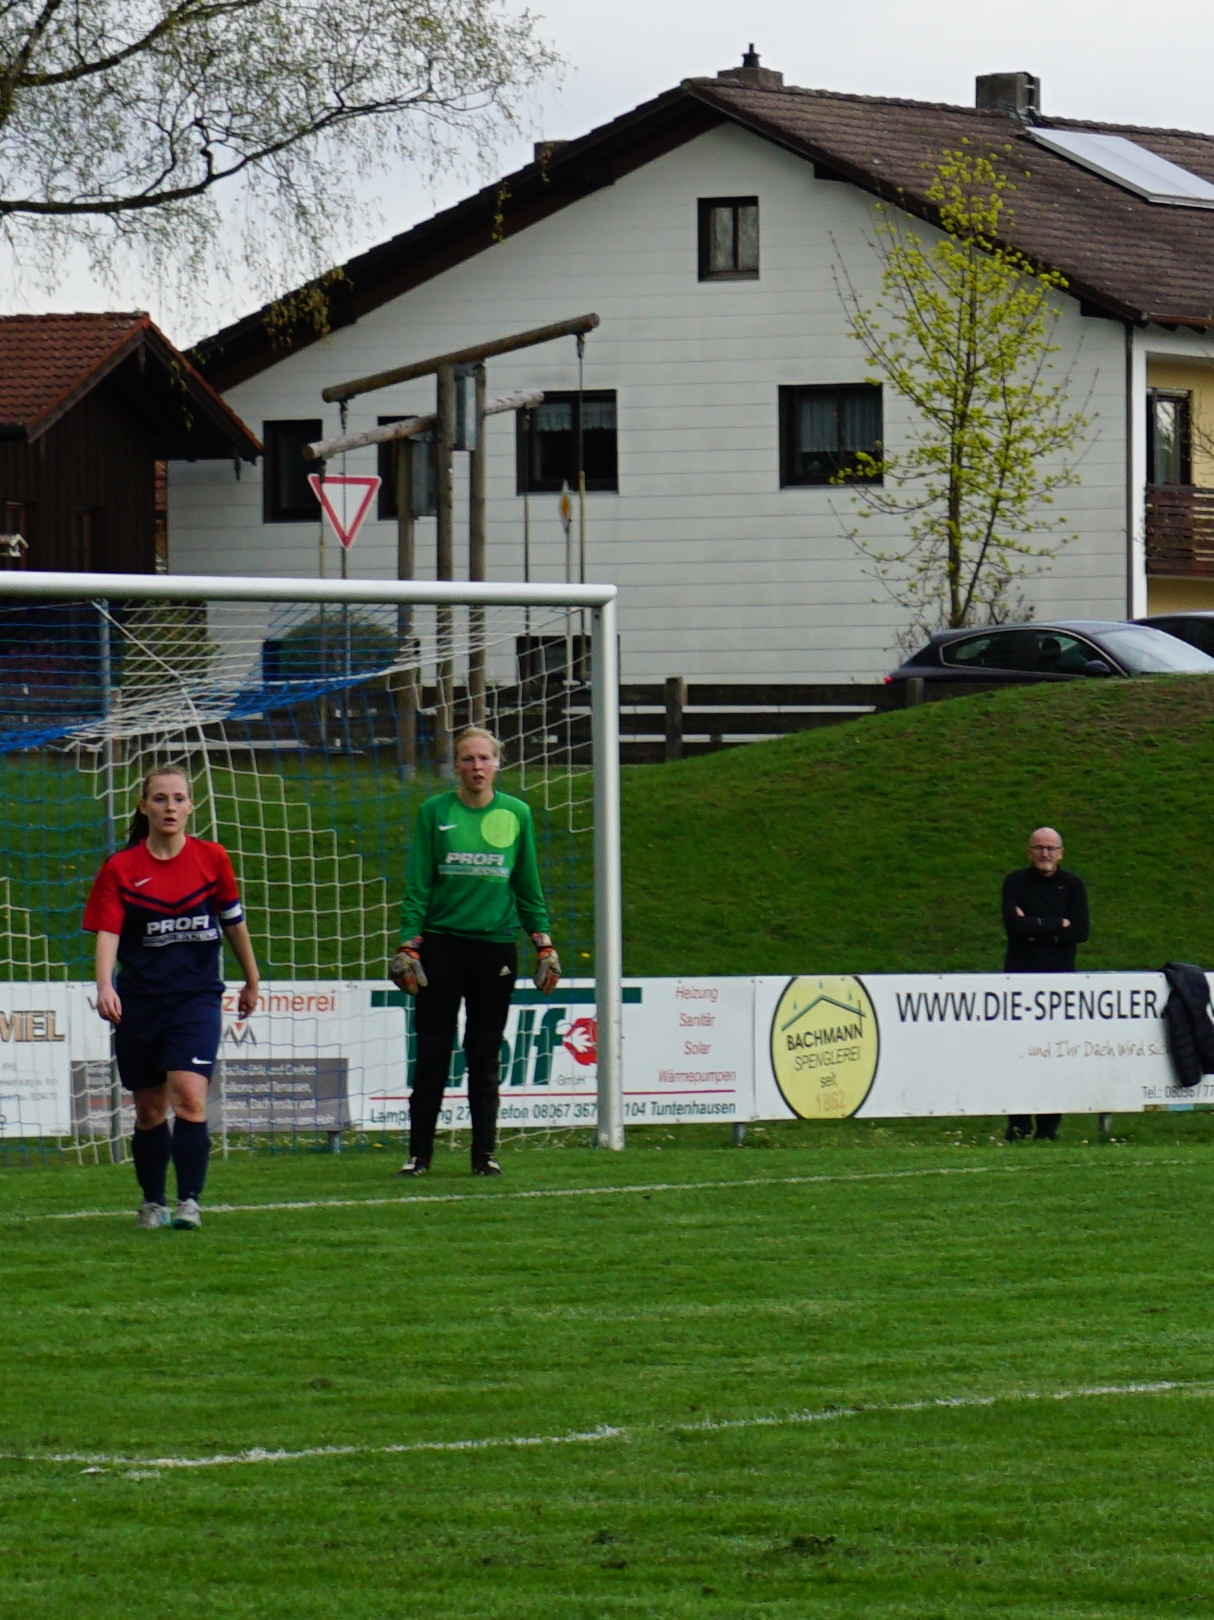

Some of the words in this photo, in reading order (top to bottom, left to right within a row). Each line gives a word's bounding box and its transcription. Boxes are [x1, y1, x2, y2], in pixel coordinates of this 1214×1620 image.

[446, 852, 505, 866] PROFI
[147, 915, 210, 935] PROFI
[676, 986, 719, 1002] Heizung
[679, 1012, 715, 1027] Sanitär
[787, 1023, 864, 1051] BACHMANN
[684, 1041, 711, 1055] Solar
[794, 1046, 861, 1071] SPENGLEREI
[658, 1069, 736, 1085] Wärmepumpen
[650, 1101, 736, 1115] Tuntenhausen
